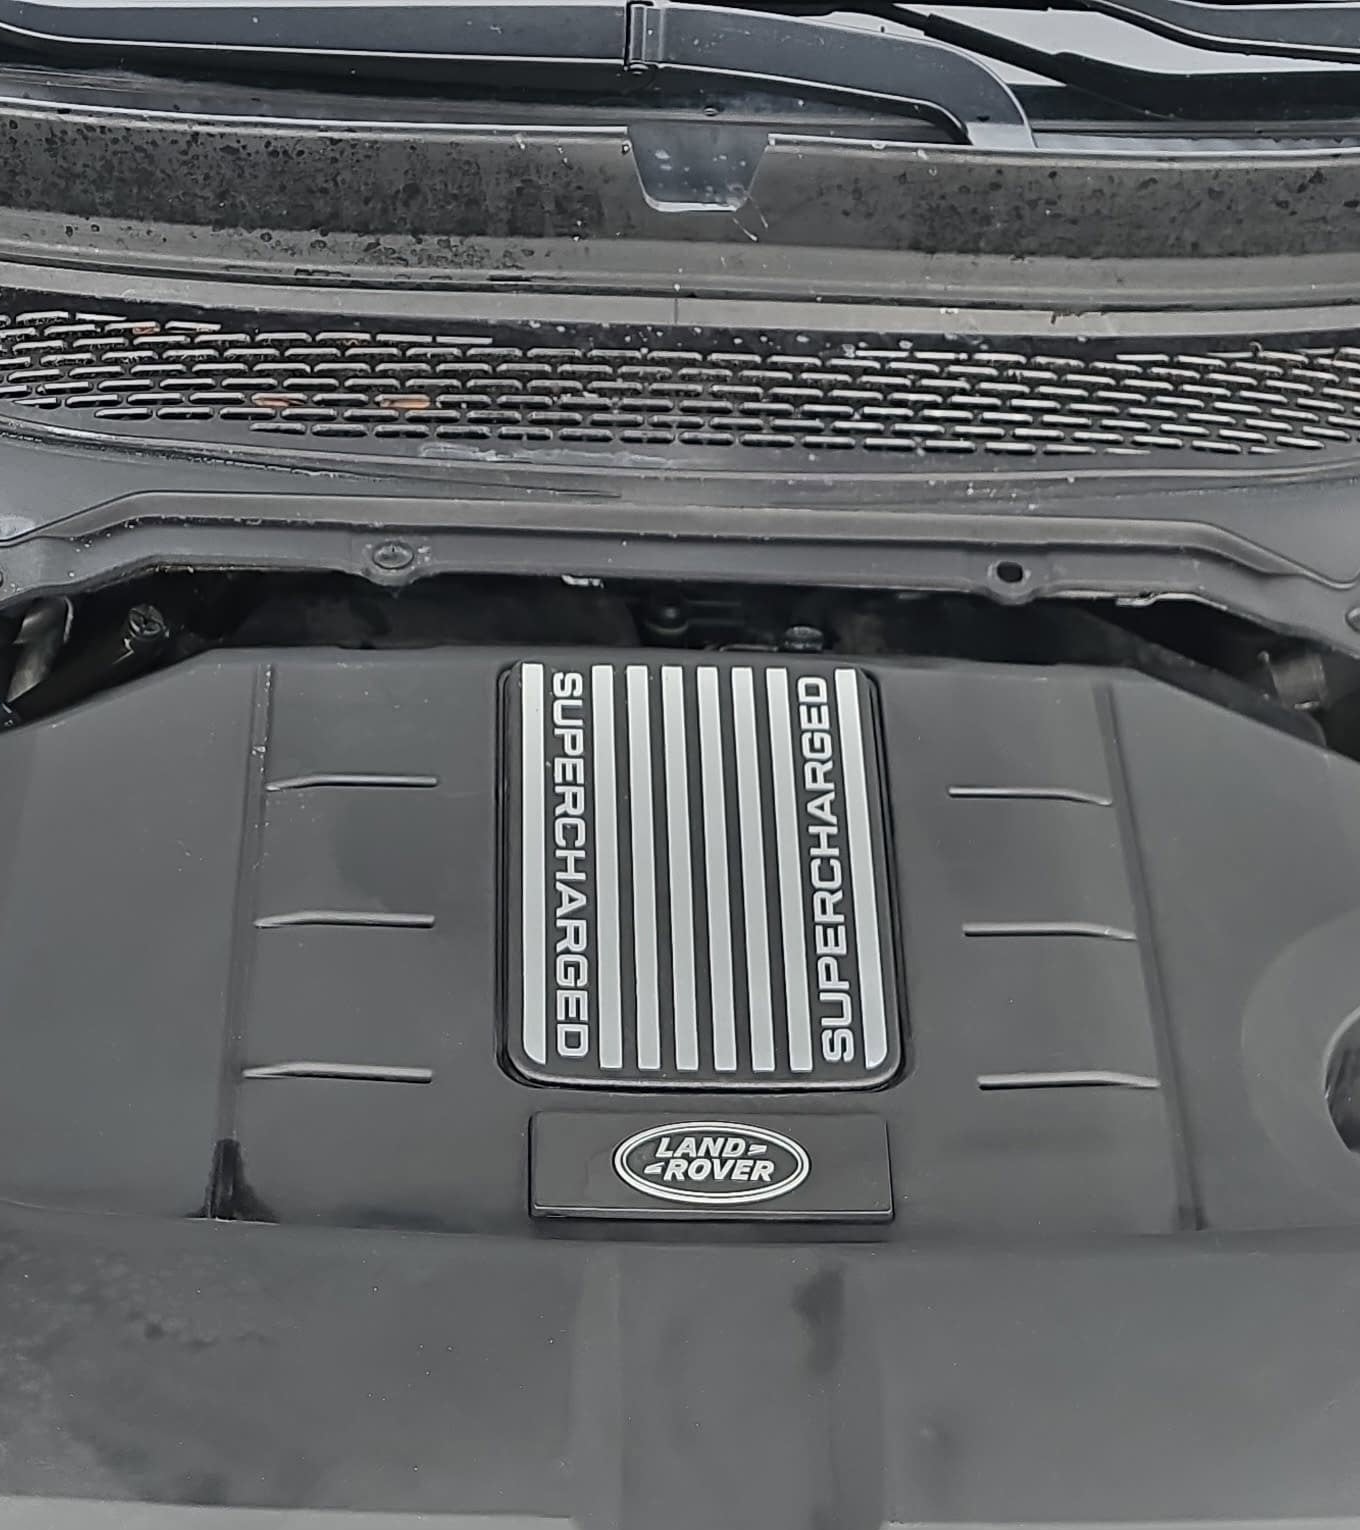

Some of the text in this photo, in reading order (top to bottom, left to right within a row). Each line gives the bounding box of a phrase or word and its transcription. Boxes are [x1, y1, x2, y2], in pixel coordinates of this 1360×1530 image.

[552, 671, 589, 1058] SUPERCHARGED
[797, 676, 854, 1063] SUPERCHARGED
[655, 1137, 745, 1158] LAND
[664, 1159, 773, 1182] ROVER
